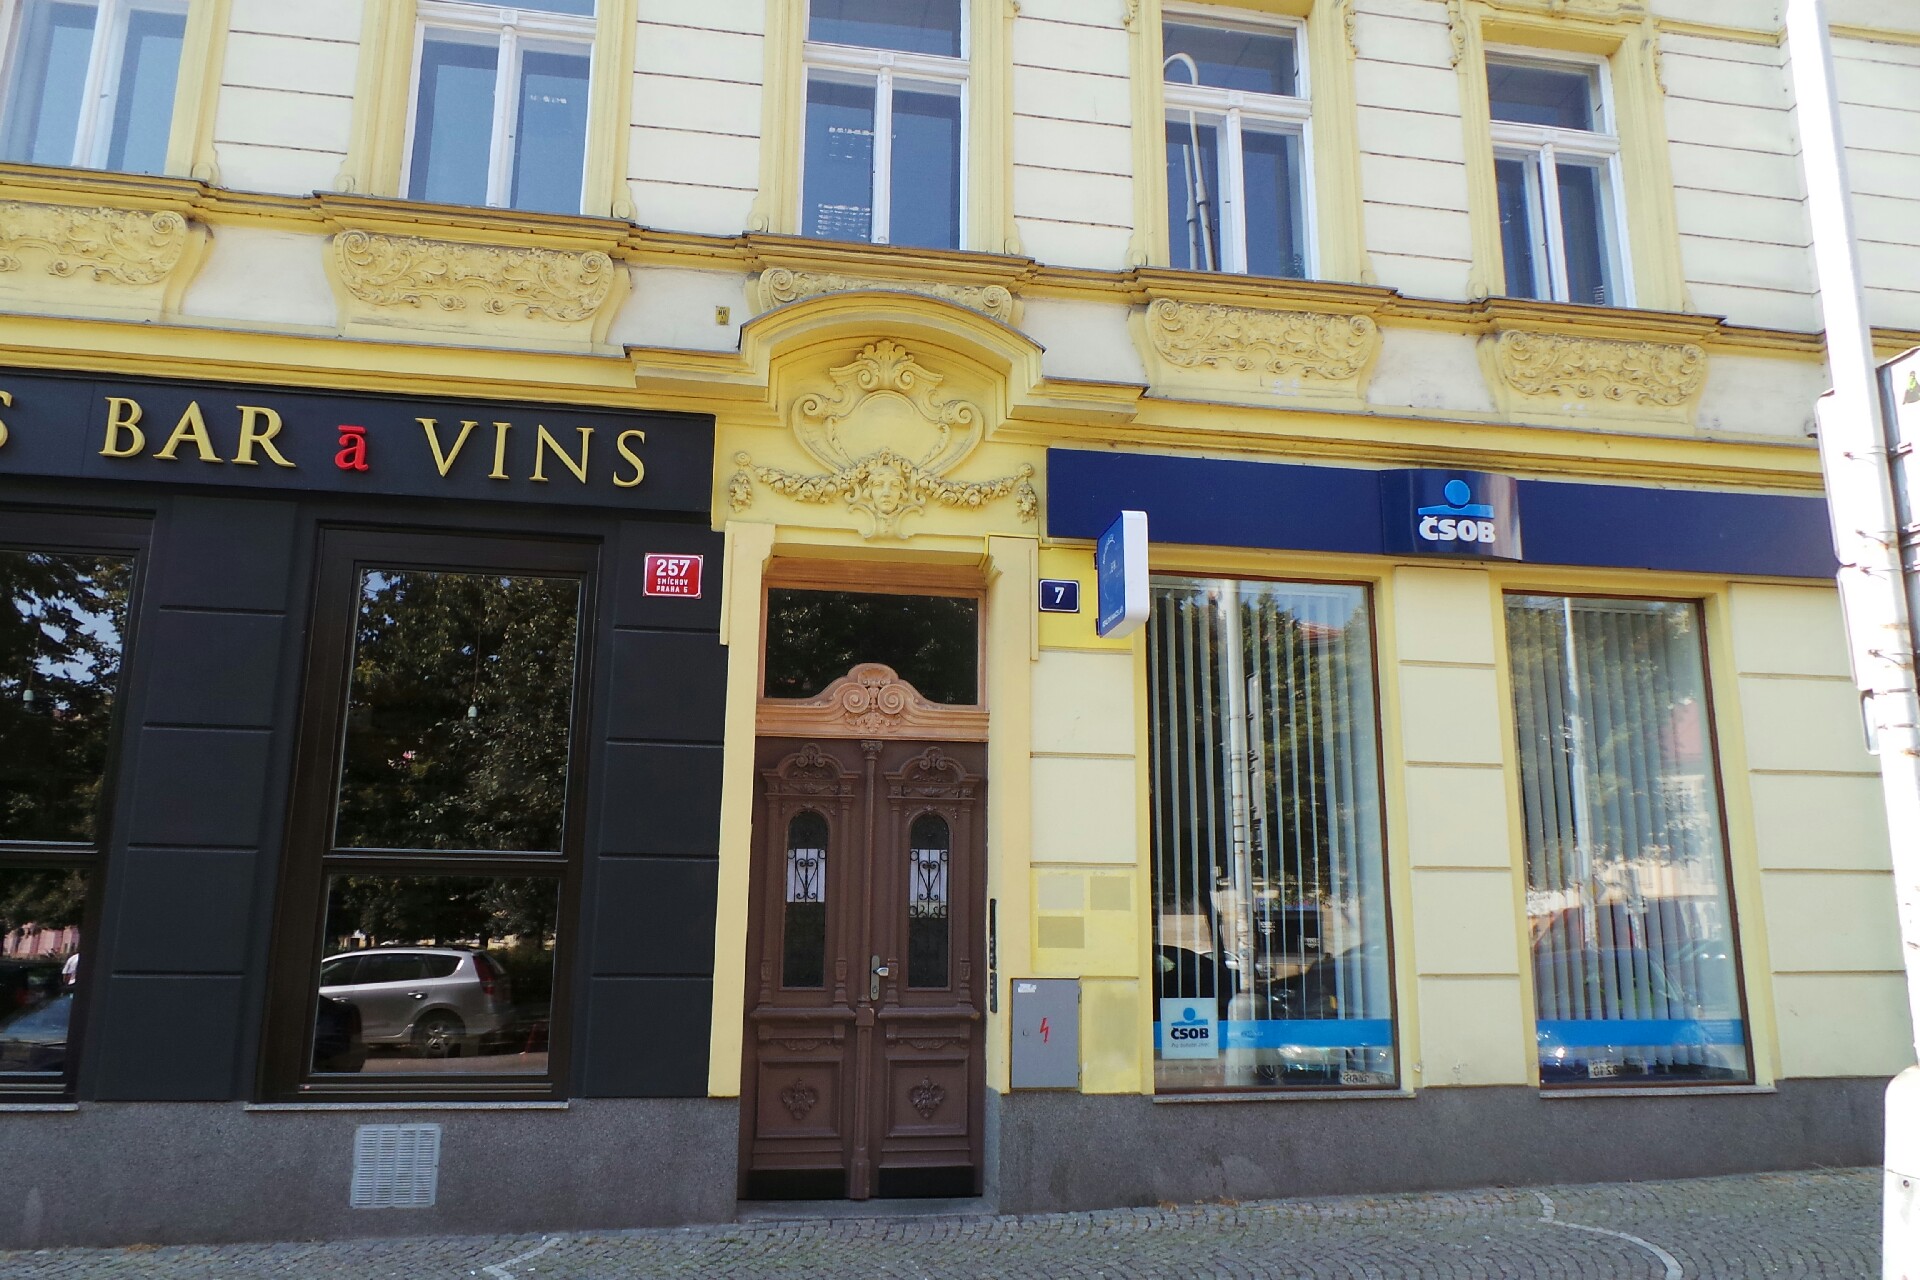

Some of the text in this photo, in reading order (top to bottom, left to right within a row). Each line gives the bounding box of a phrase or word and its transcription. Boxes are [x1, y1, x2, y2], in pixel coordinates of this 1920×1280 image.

[98, 396, 297, 468] BAR
[415, 417, 646, 488] VINS
[1419, 515, 1496, 543] ČSOB
[656, 559, 690, 576] 257
[657, 577, 688, 585] SMÍCHOV
[1055, 587, 1065, 604] 7
[1171, 1027, 1209, 1040] ČSOB
